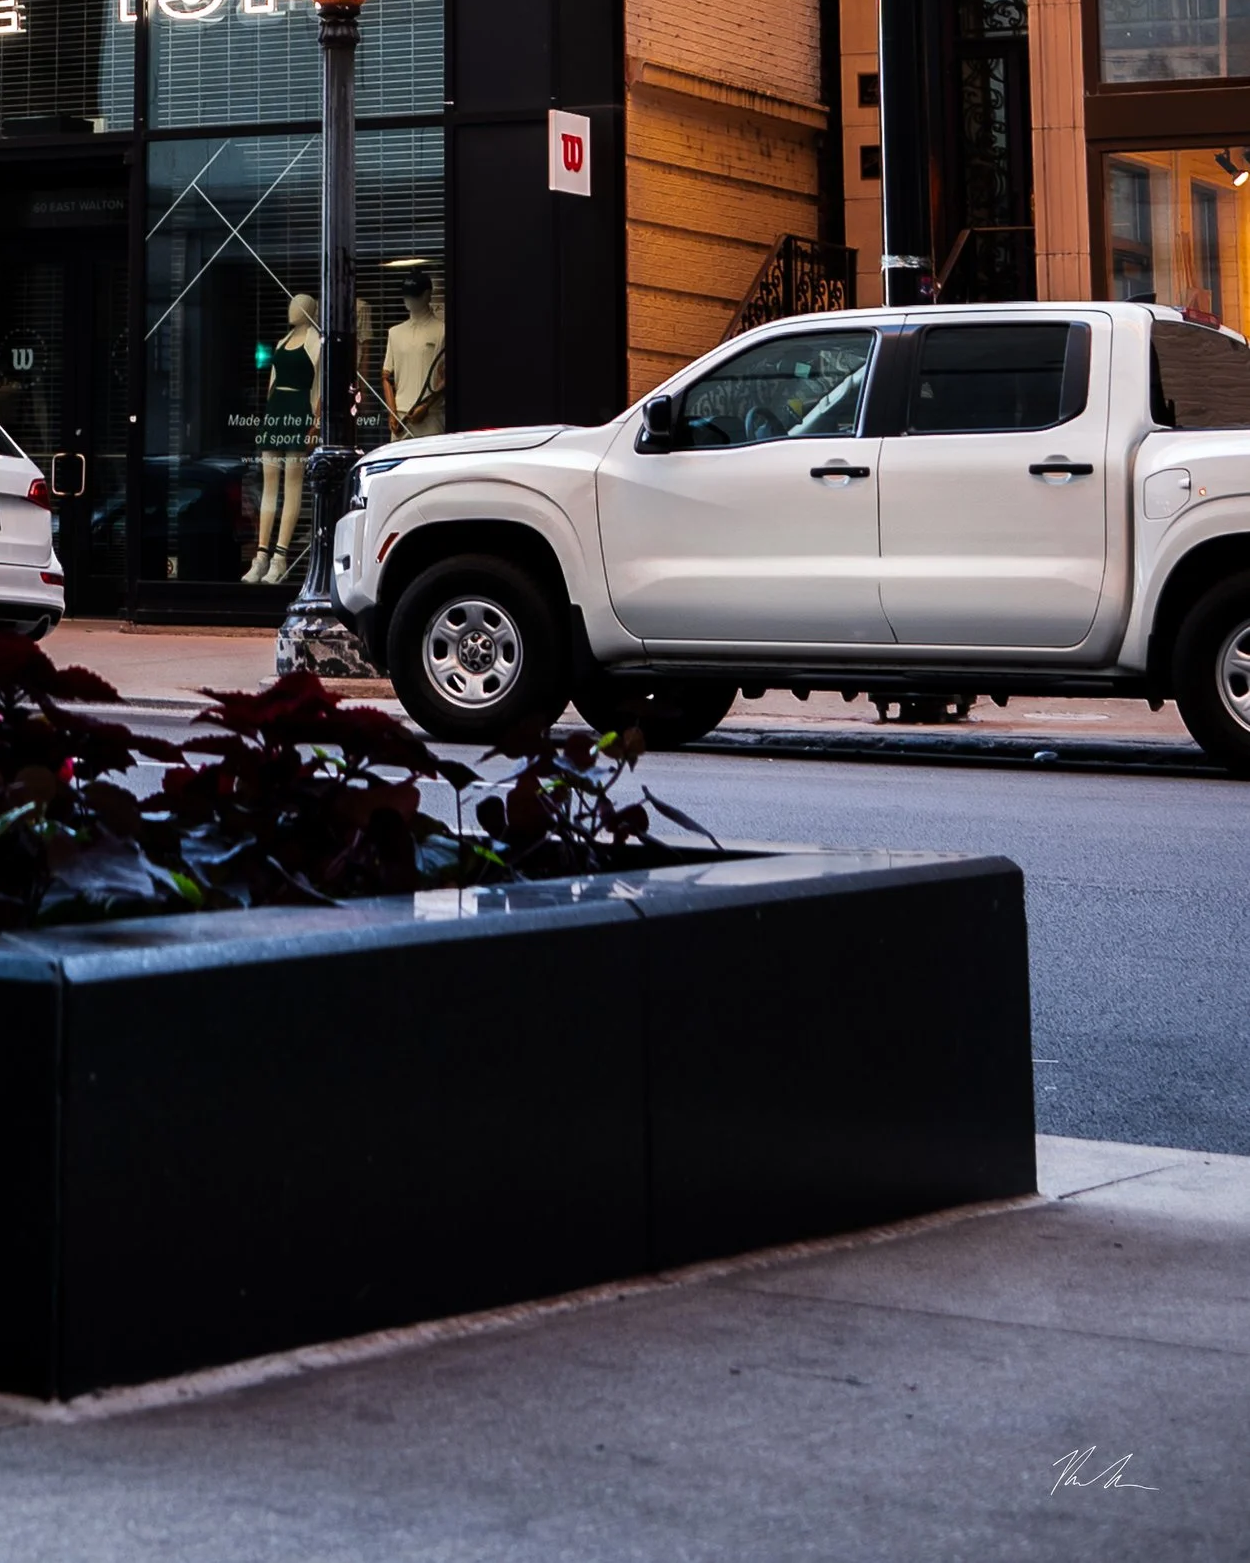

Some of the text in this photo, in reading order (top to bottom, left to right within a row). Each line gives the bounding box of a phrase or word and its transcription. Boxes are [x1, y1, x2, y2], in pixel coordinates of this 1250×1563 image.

[561, 132, 584, 173] W
[49, 201, 76, 213] EAST
[78, 199, 124, 212] WALTON
[228, 414, 260, 426] Made
[263, 413, 280, 426] for
[283, 413, 302, 426] the
[356, 414, 380, 426] evel
[255, 431, 268, 444] of
[270, 433, 301, 447] sport
